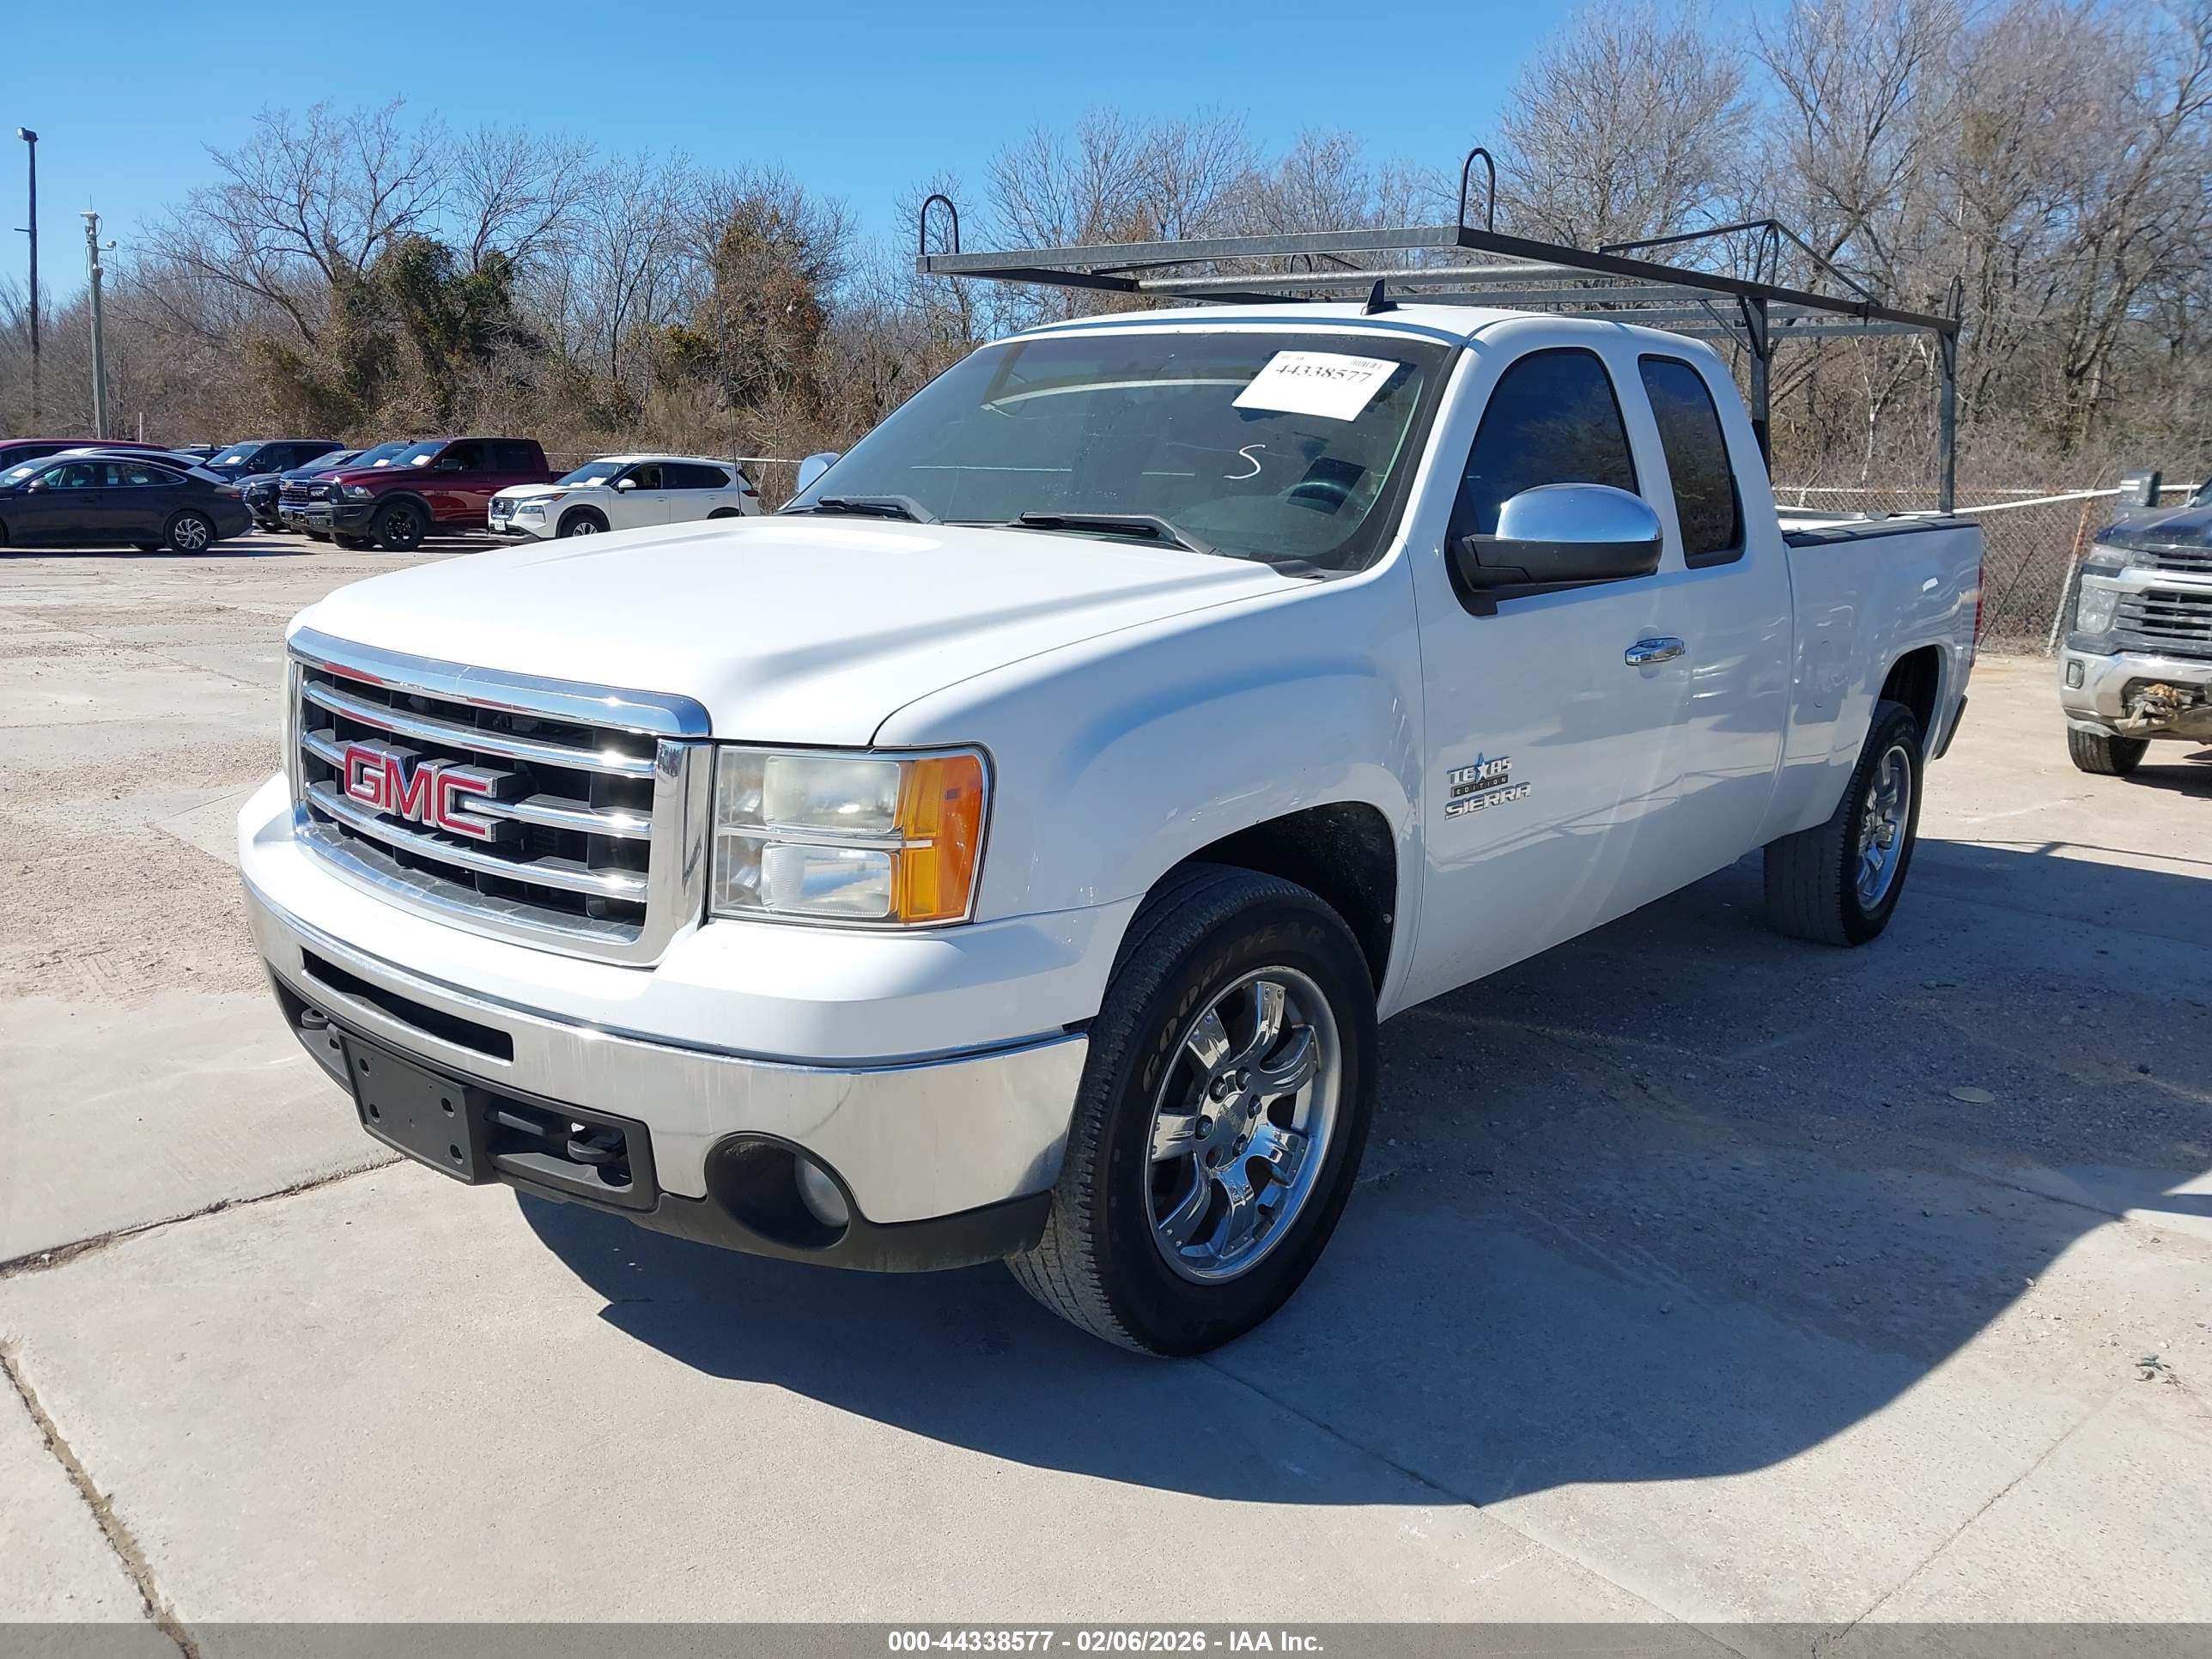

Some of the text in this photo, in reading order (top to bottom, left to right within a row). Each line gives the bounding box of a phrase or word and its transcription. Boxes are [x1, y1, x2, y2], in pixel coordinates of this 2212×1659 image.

[1274, 362, 1375, 384] 44338577
[1449, 755, 1512, 785] TEXAS
[1455, 776, 1509, 795] EDITION
[344, 742, 495, 842] GMC
[1444, 781, 1533, 820] SIERRA
[1142, 919, 1328, 1094] GOODYEAR
